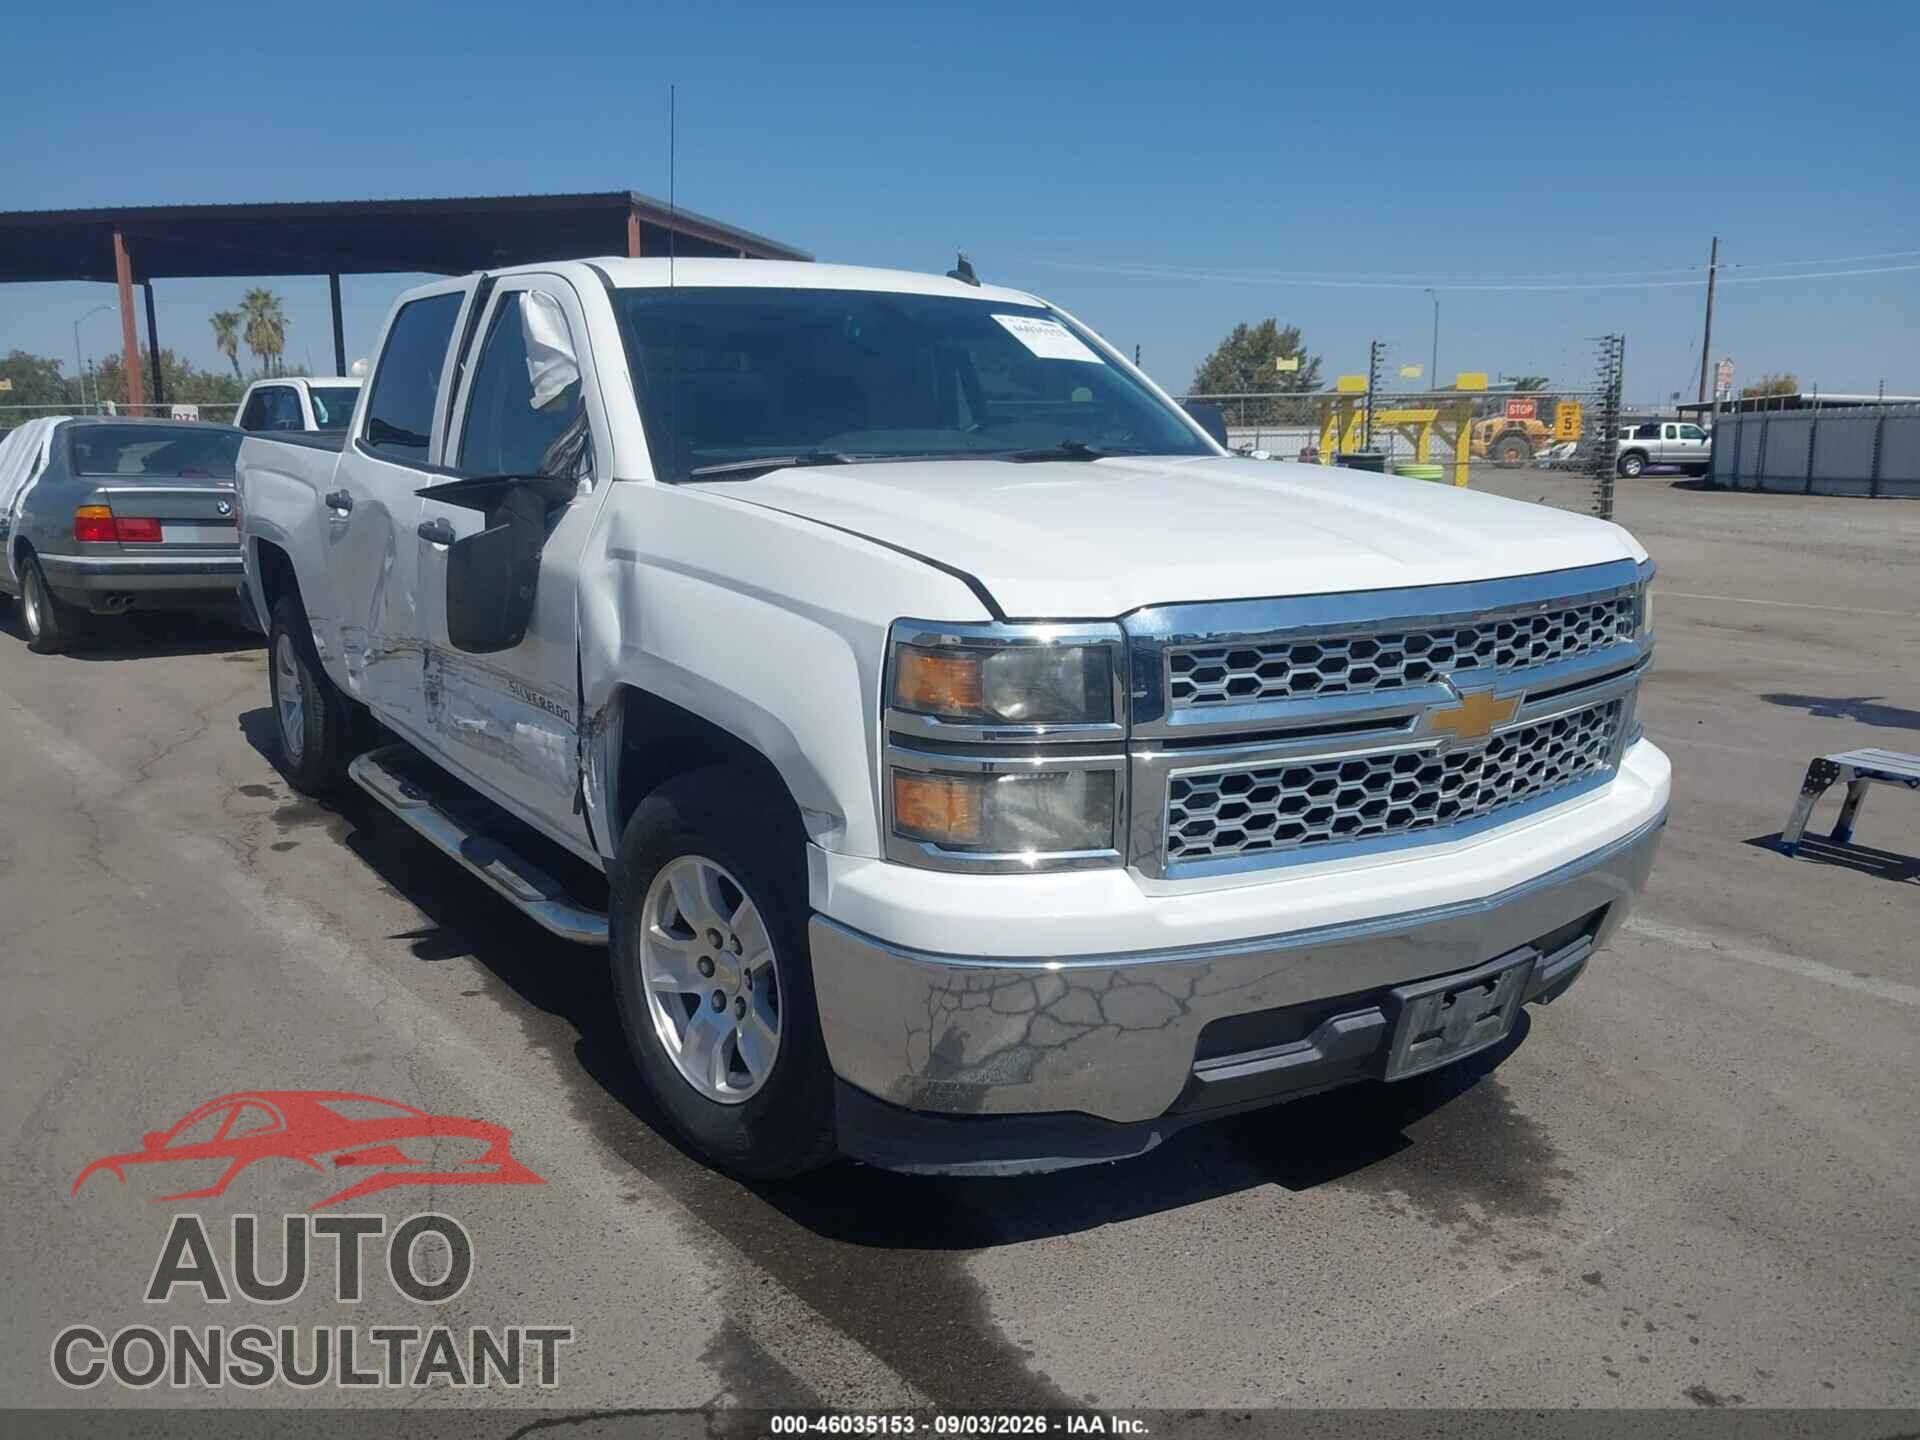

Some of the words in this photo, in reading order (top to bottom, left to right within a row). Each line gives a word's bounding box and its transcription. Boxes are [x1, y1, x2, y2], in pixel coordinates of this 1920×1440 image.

[1509, 404, 1534, 416] STOP
[1563, 417, 1573, 430] 5
[507, 680, 570, 721] SILVERADO
